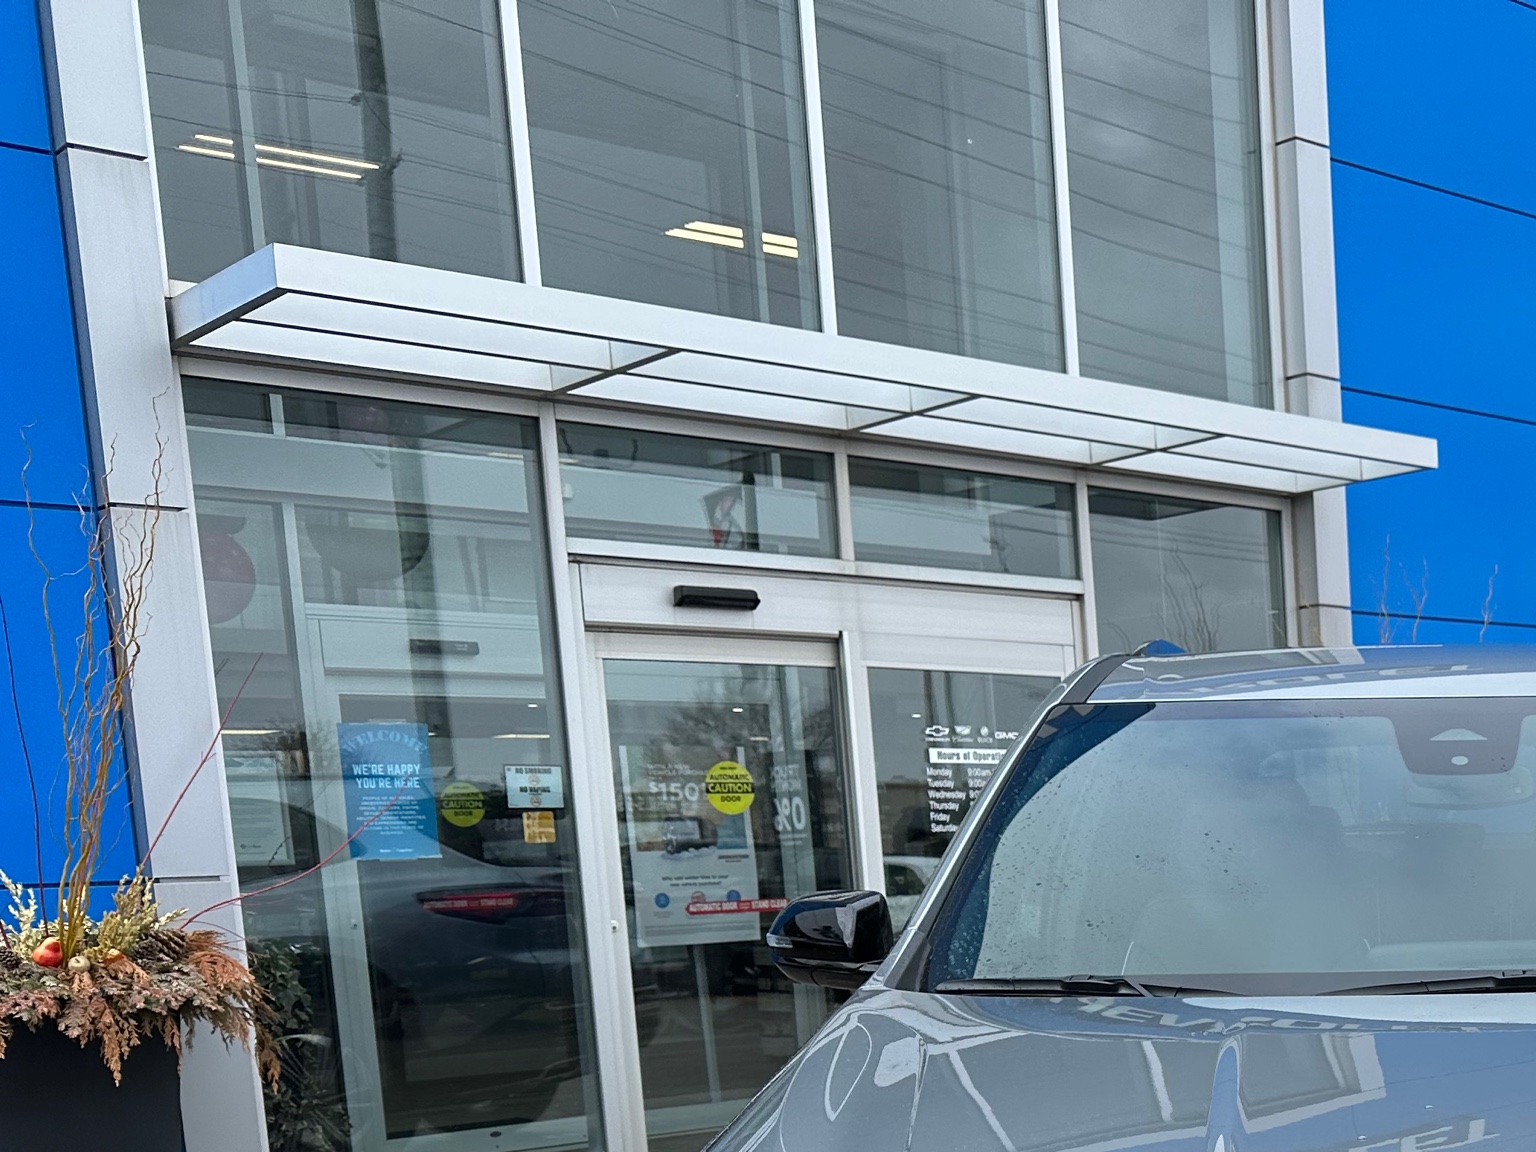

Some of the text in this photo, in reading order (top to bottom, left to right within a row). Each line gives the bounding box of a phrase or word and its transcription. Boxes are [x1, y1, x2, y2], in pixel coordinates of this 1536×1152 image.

[994, 731, 1019, 740] GMC
[342, 729, 428, 755] WELCOME
[937, 750, 961, 761] Hours
[352, 763, 421, 776] WE'RE HAPPY
[926, 767, 952, 779] Monday
[355, 777, 421, 789] YOU'RE HERE
[708, 783, 752, 794] CAUTION
[927, 778, 955, 790] Tuesday
[720, 795, 742, 803] DOOR
[928, 790, 967, 801] Wednesday
[442, 800, 482, 809] CAUTION
[929, 801, 960, 812] Thursday
[930, 812, 951, 823] Friday
[931, 823, 959, 833] Saturda
[688, 899, 788, 913] AUTOMATIC DOOR STAND CLEAR
